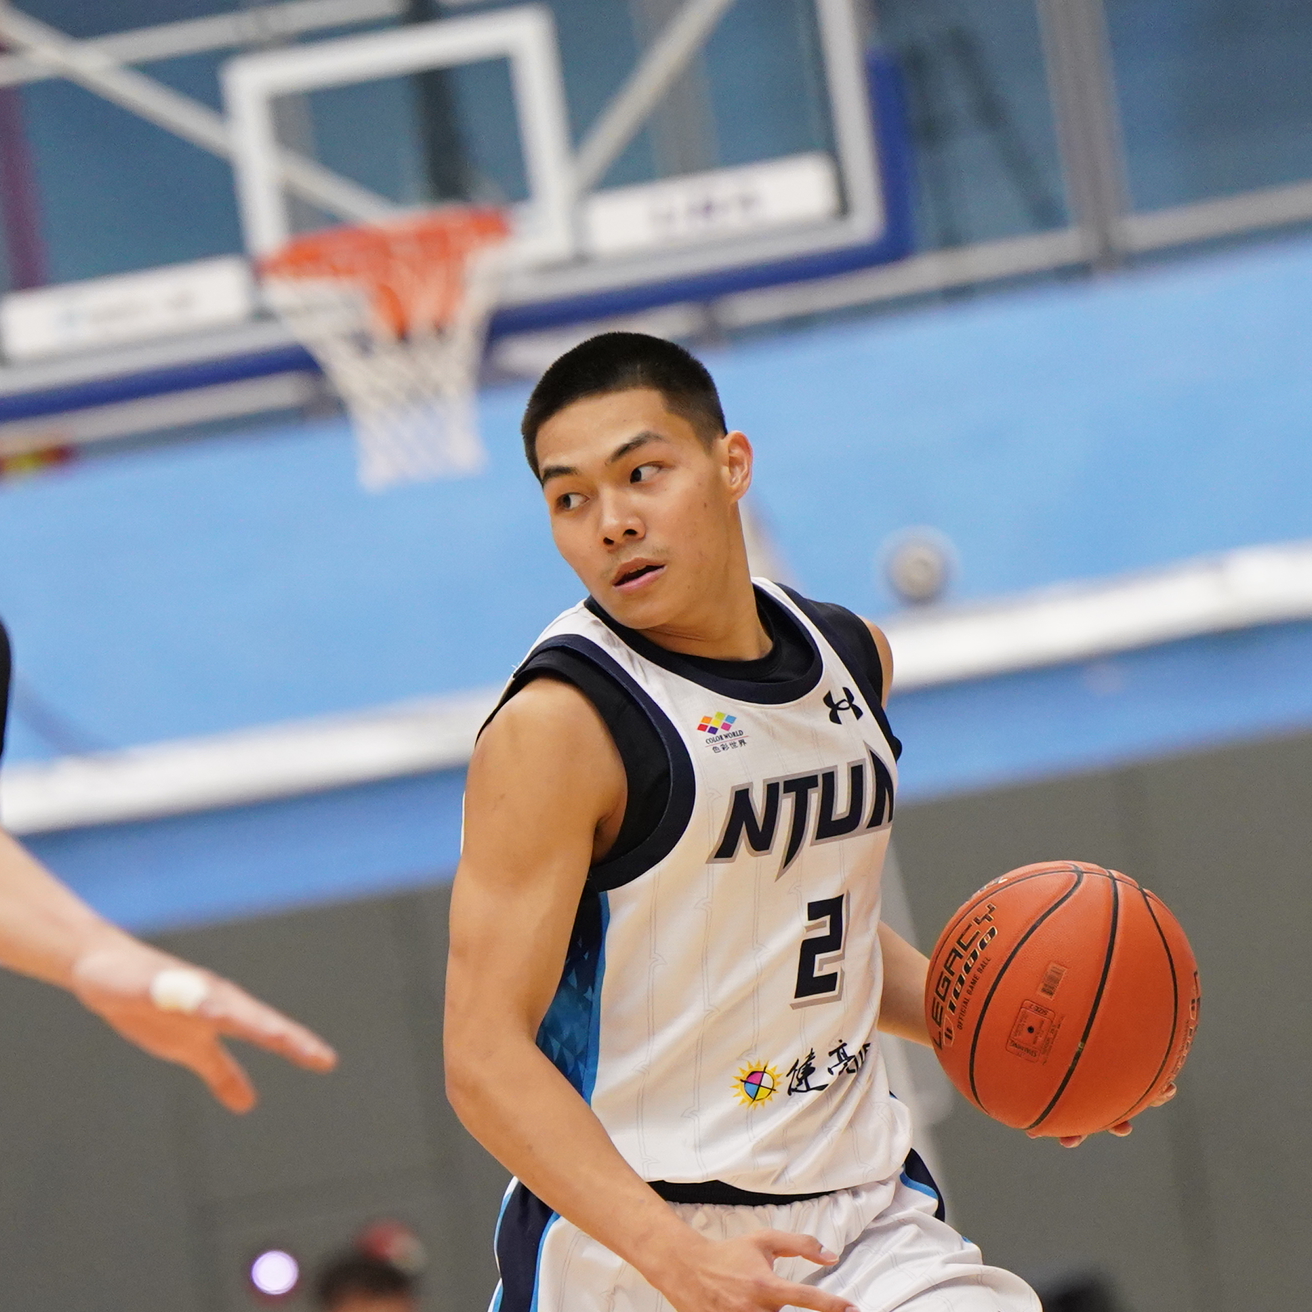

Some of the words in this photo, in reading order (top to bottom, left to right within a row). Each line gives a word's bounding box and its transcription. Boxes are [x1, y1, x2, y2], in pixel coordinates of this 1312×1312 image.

[705, 734, 725, 745] COLOR
[723, 729, 744, 739] WORLD
[712, 738, 747, 753] 色彩世界
[791, 892, 848, 1007] 2
[931, 903, 997, 1050] LEGACY
[947, 926, 998, 1015] 1000
[957, 998, 970, 1030] OFFICIAL
[966, 975, 980, 996] GAME
[976, 956, 991, 974] BALL
